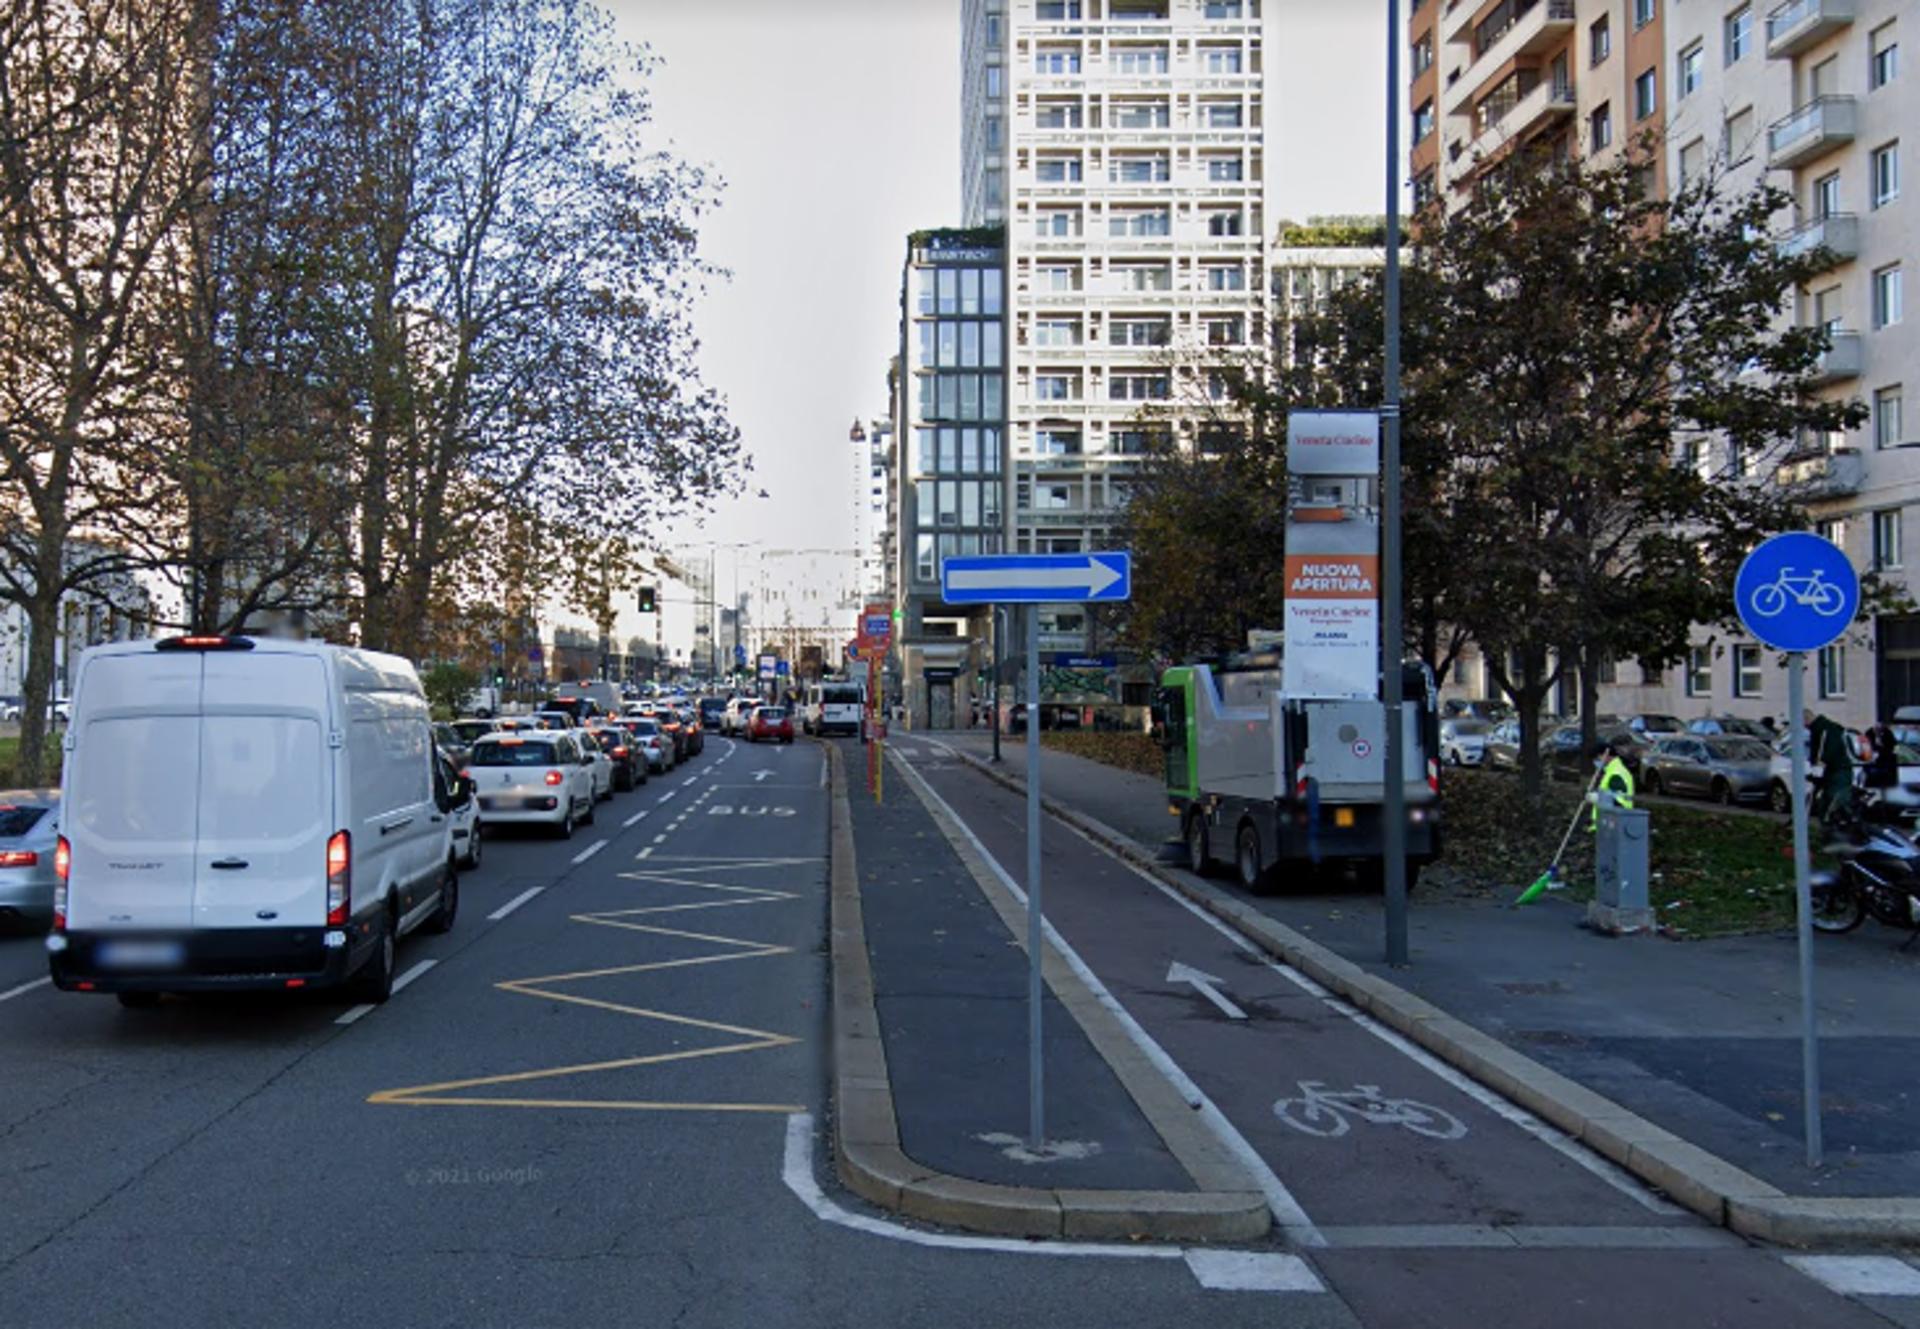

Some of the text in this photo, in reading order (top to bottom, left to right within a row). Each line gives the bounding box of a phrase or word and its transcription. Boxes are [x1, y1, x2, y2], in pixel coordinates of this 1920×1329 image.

[1302, 564, 1361, 577] NUOVA
[1291, 577, 1372, 591] APERTURA
[708, 805, 797, 817] BUS
